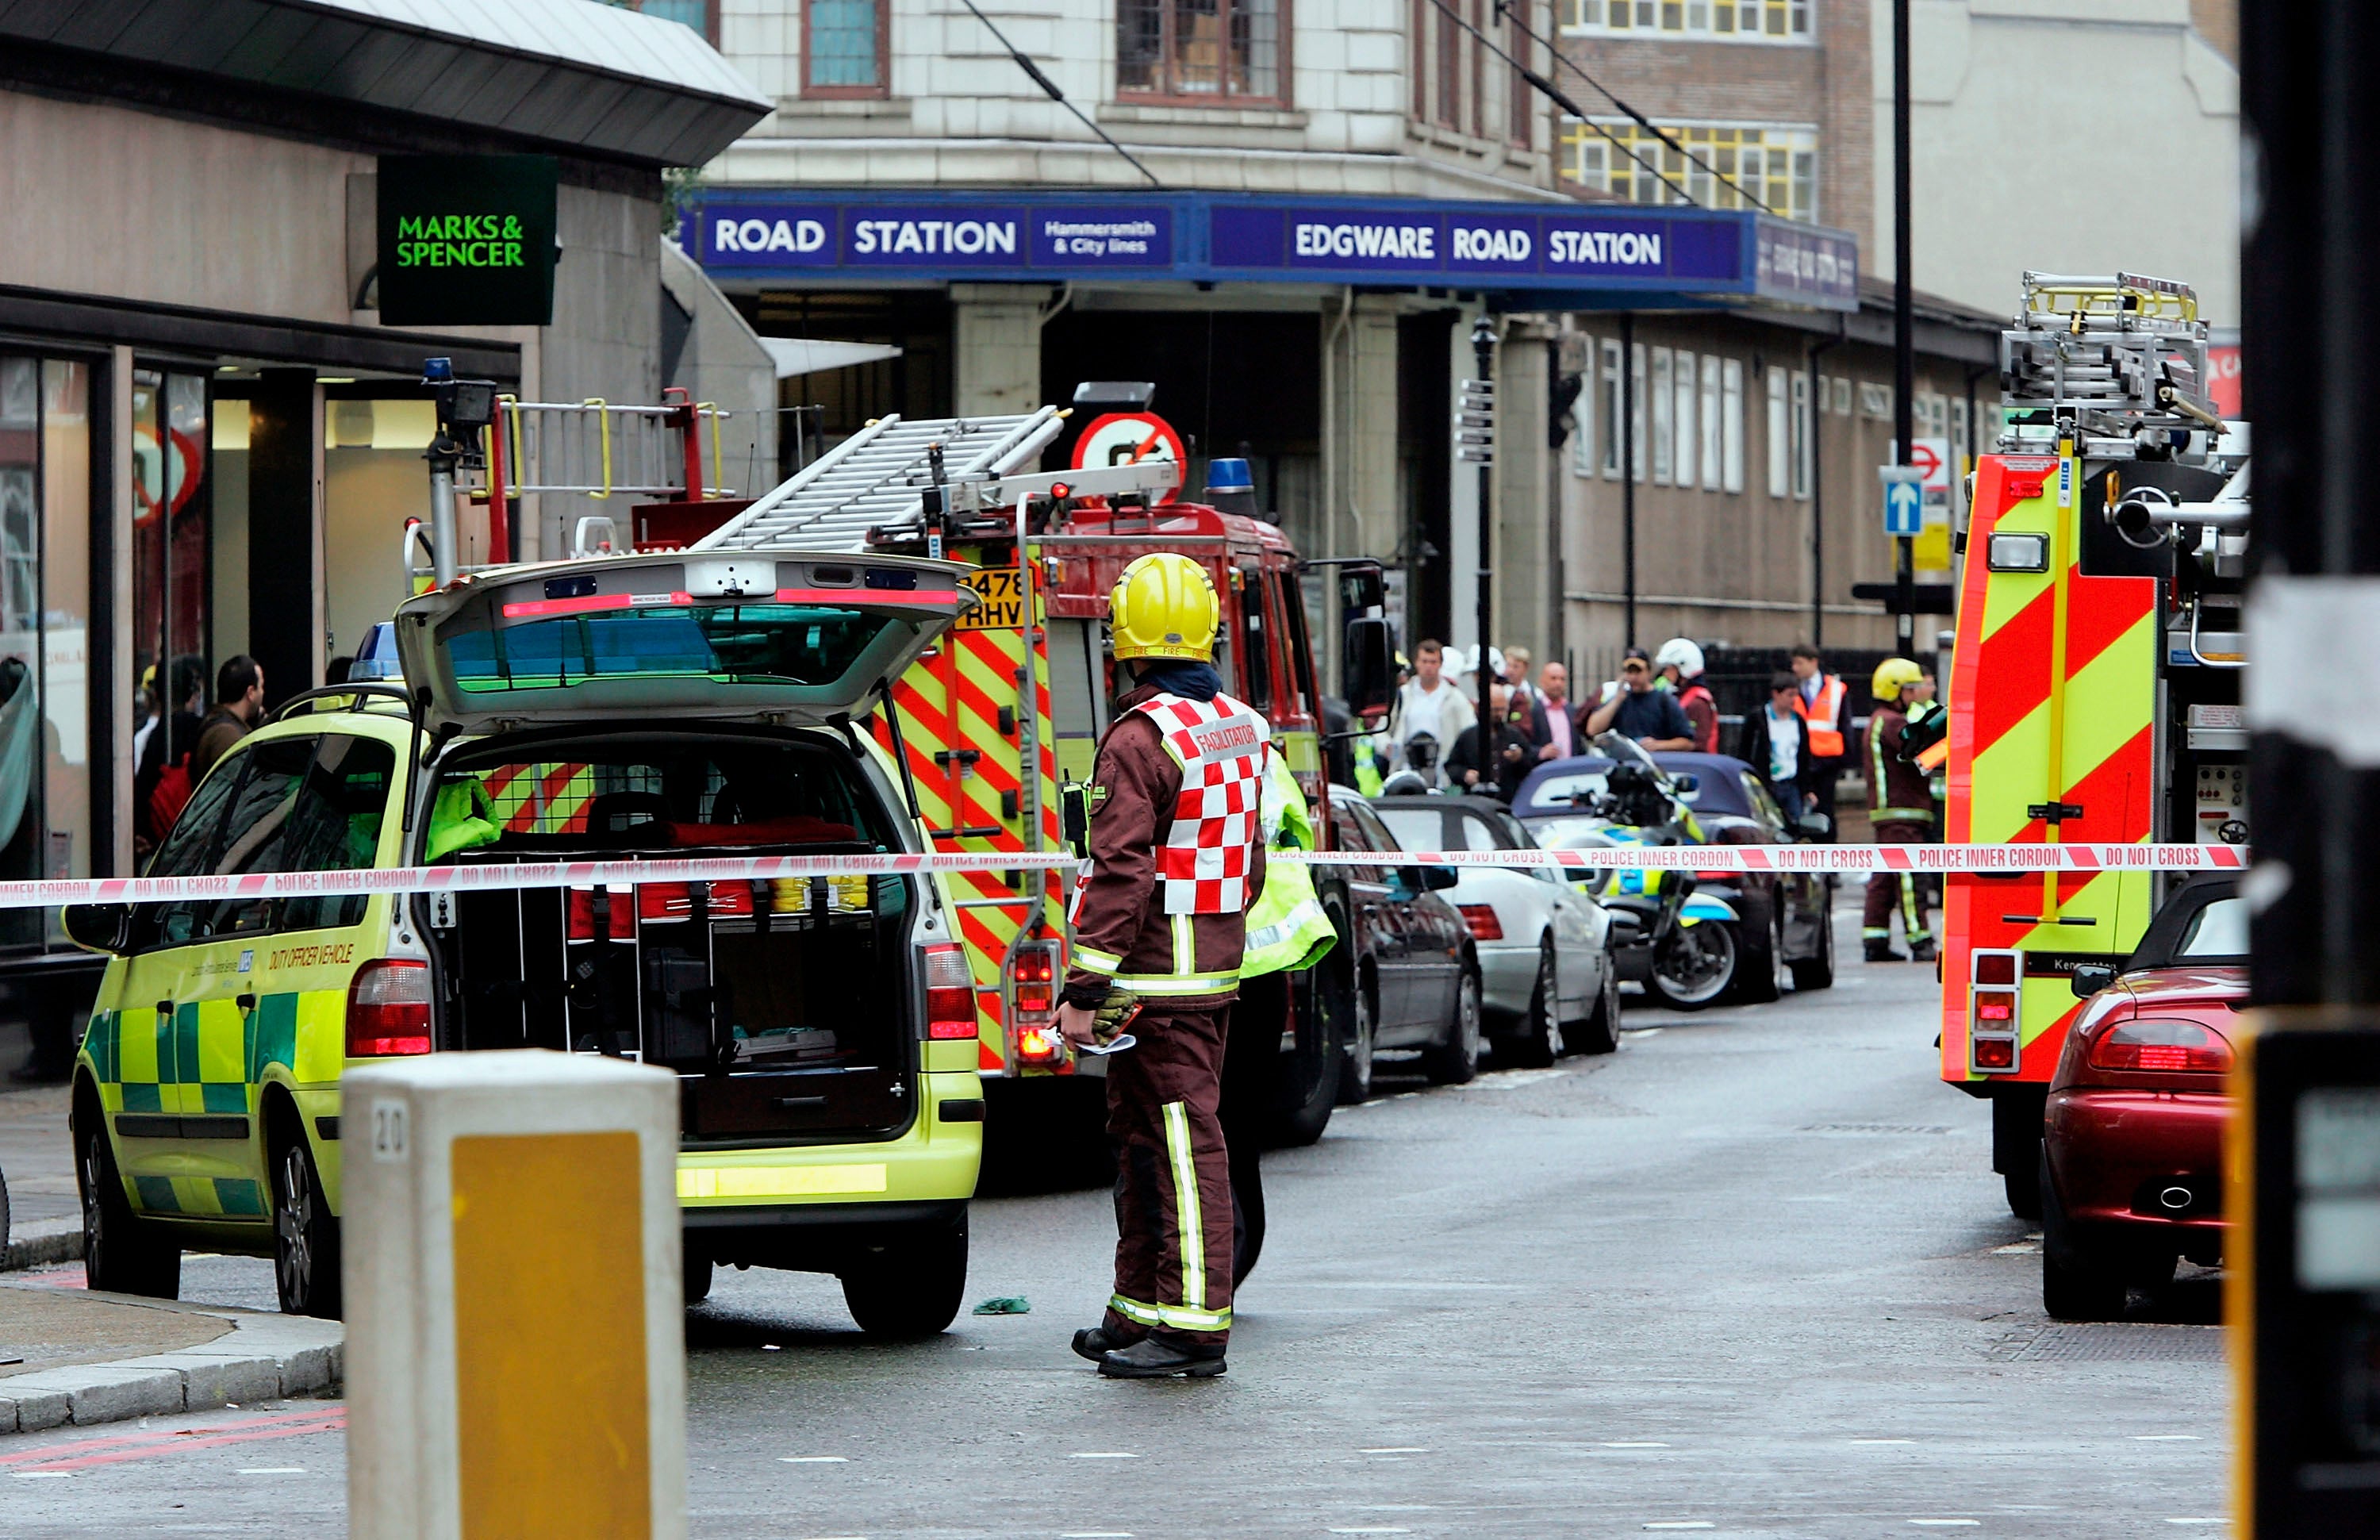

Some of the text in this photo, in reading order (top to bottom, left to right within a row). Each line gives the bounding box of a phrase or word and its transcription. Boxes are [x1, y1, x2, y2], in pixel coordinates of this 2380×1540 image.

[716, 220, 826, 252] ROAD
[854, 220, 1016, 255] STATION
[1044, 221, 1157, 236] Hammersmith
[397, 241, 525, 267] SPENCER
[1070, 237, 1107, 257] City
[1296, 224, 1662, 265] EDGWARE ROAD STATION
[966, 601, 1022, 626] RHV
[1134, 647, 1149, 655] FIRE
[1163, 647, 1180, 656] FIRE
[1196, 724, 1257, 753] FACILITATOR
[1472, 851, 1496, 863] NOT
[1502, 851, 1545, 864] CROSS
[1591, 851, 1733, 867] POLICE INNER CORDON
[1779, 849, 1872, 868] DO NOT CROSS
[1919, 847, 2061, 867] POLICE INNER CORDON
[2106, 847, 2199, 866] DO NOT CROSS
[269, 943, 354, 970] DUTY OFFICER VEHICLE
[374, 1108, 404, 1154] 20
